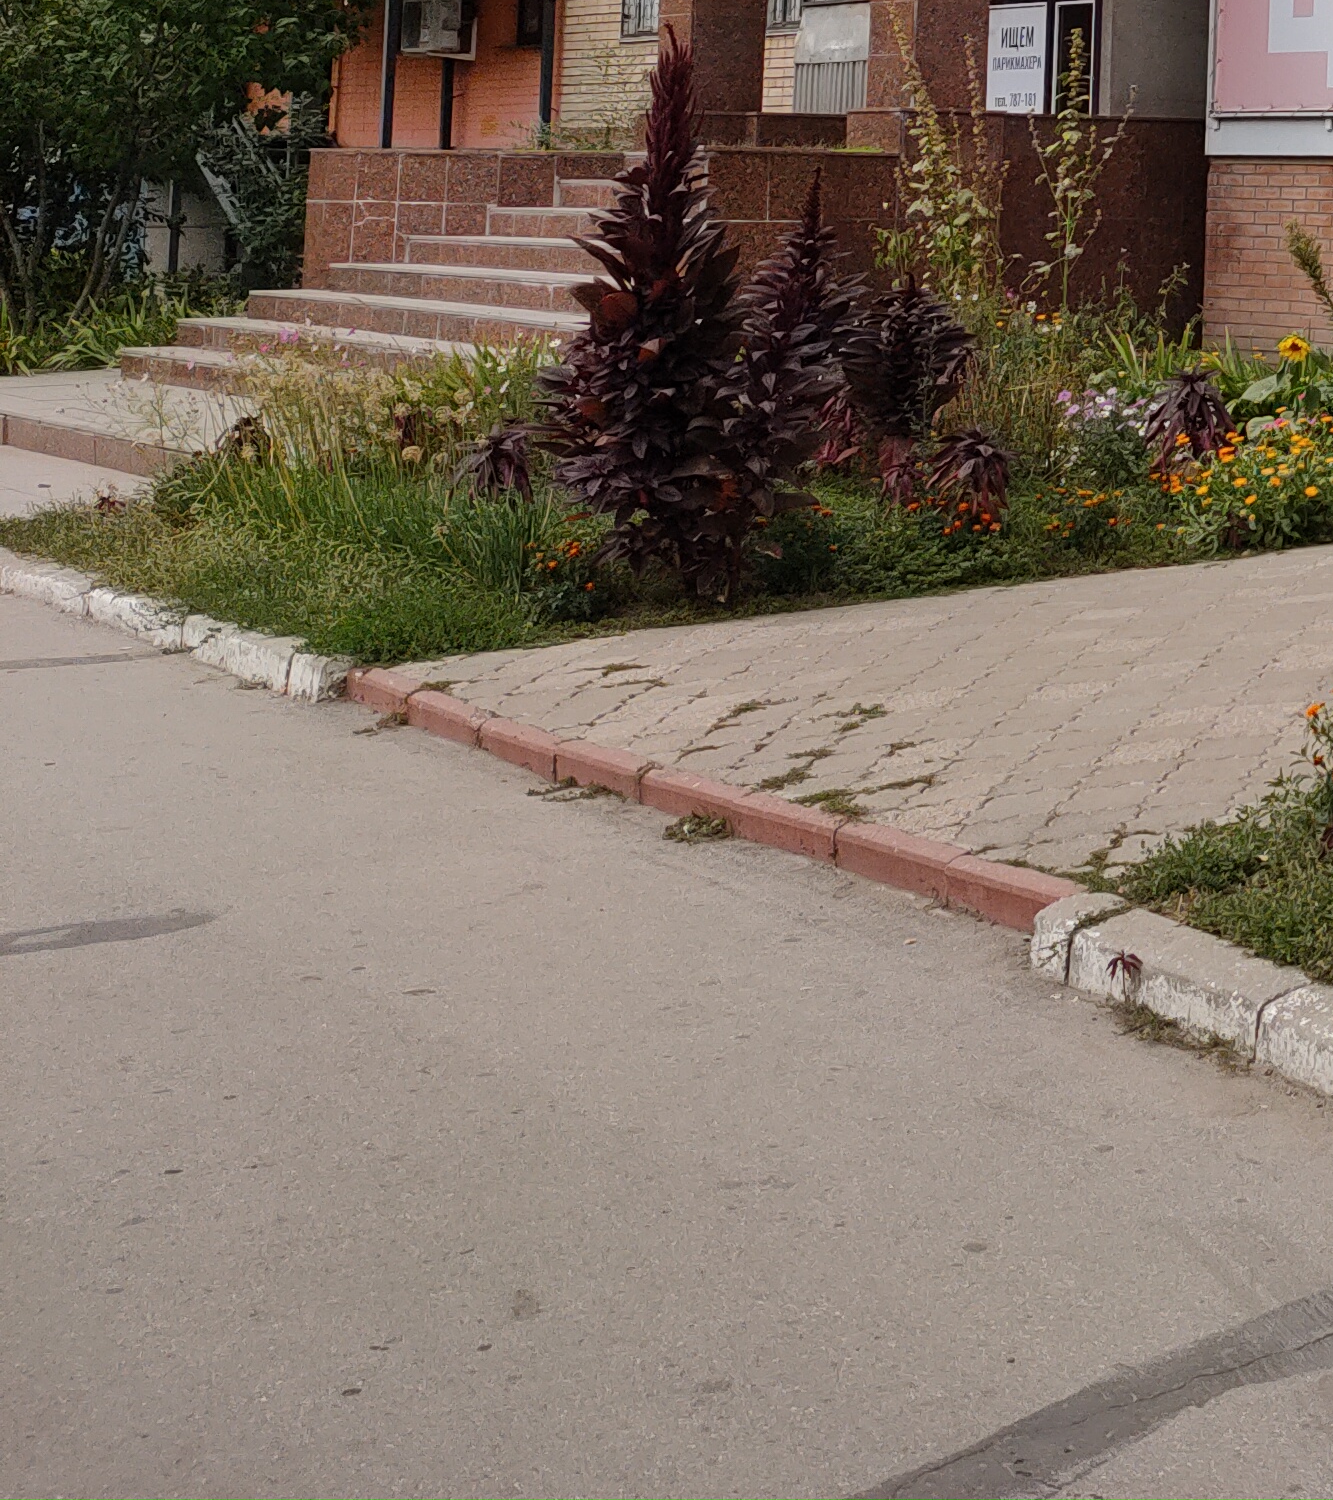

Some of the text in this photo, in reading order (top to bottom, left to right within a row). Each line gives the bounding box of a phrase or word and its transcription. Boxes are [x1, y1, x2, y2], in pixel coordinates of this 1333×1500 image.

[1001, 25, 1035, 51] ИЩЕМ
[992, 54, 1042, 72] ПАРИКМАХЕРА
[1009, 92, 1037, 108] 787-181
